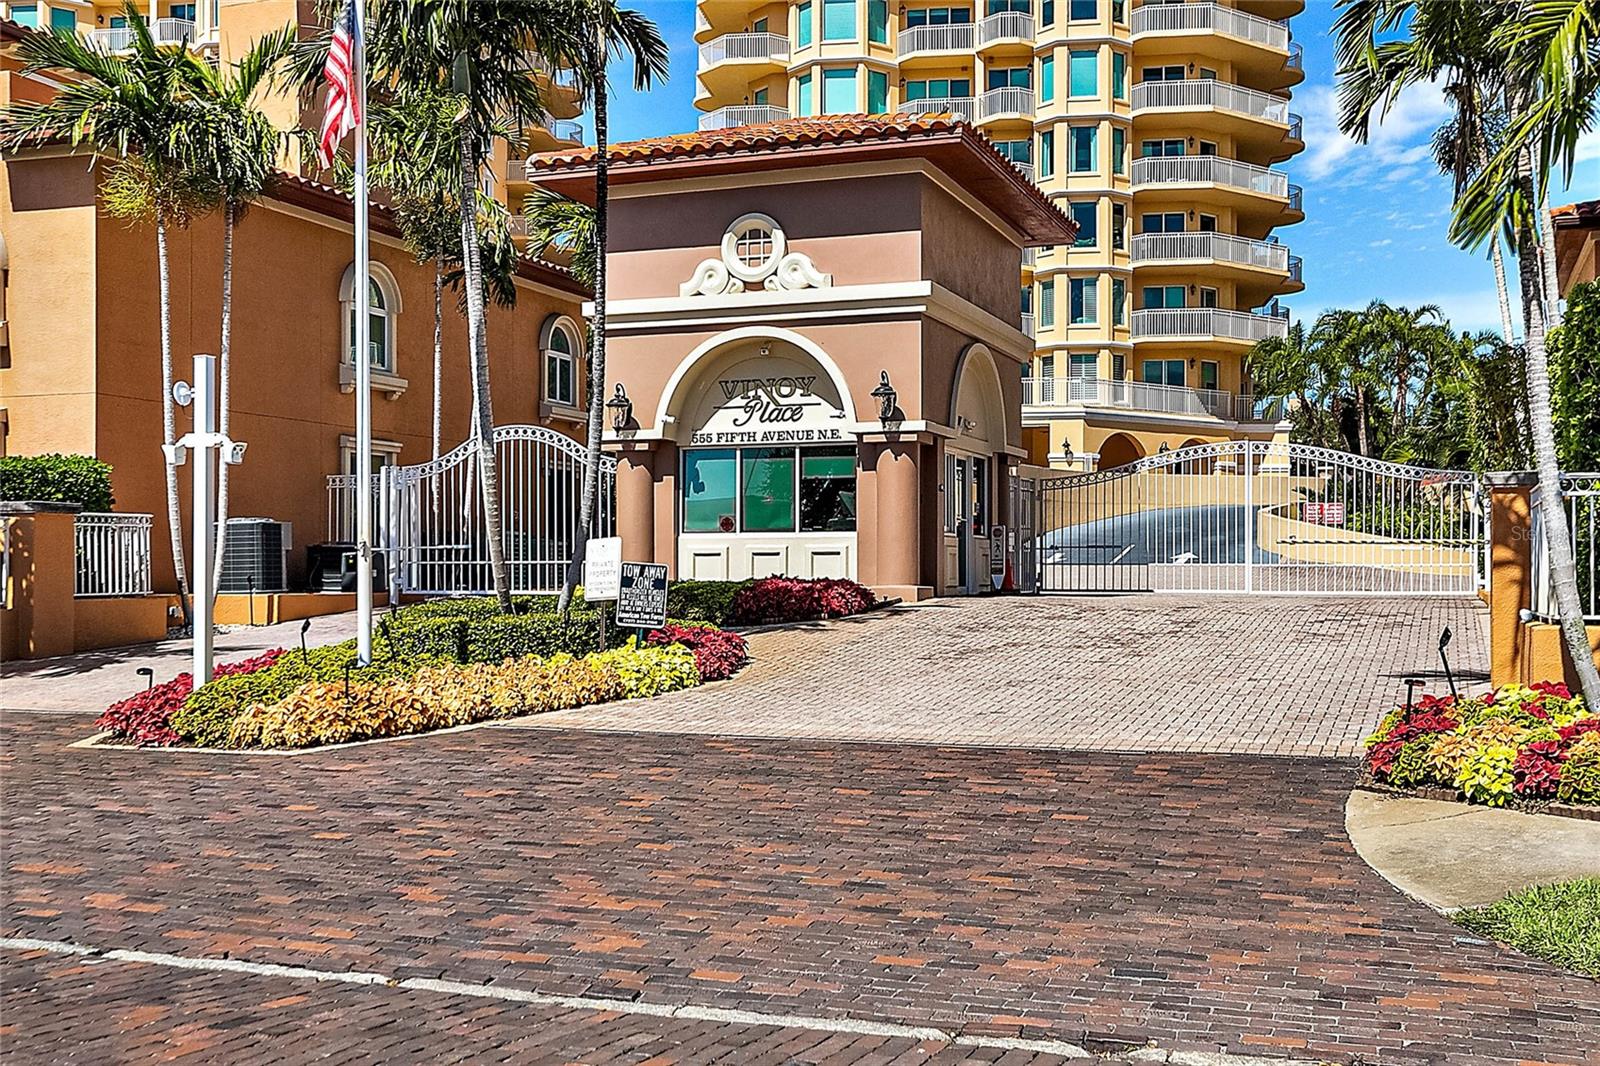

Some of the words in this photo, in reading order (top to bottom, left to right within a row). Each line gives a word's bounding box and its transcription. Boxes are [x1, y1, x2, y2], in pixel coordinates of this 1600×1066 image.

[719, 376, 816, 405] VINOY
[733, 399, 804, 426] Place
[691, 433, 713, 444] 555
[716, 432, 757, 442] FIFTH
[760, 430, 814, 441] AVENUE
[817, 429, 842, 440] N.E.
[623, 564, 640, 577] TOW
[643, 566, 666, 579] AWAY
[632, 577, 655, 589] ZONE
